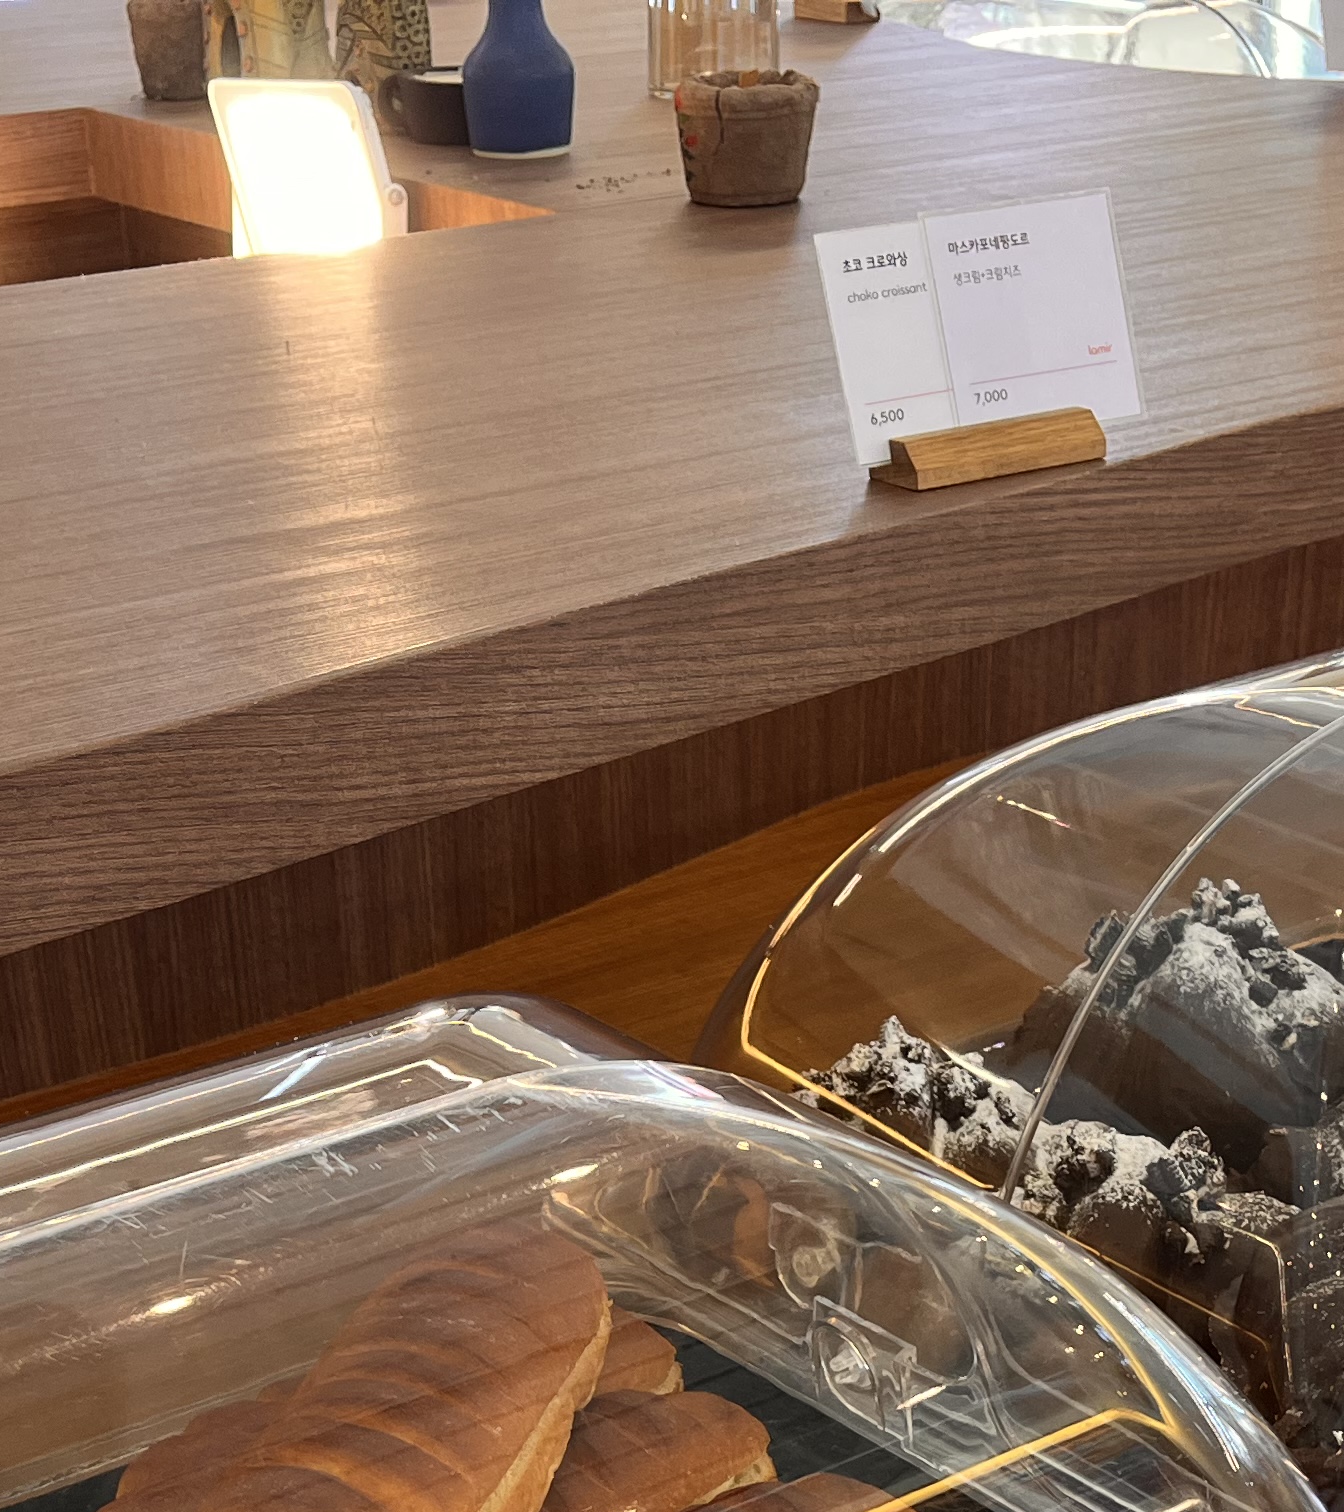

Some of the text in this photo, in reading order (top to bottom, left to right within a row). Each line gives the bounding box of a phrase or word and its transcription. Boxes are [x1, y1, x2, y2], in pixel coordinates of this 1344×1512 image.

[842, 251, 908, 274] 초코 크로와상
[847, 281, 928, 304] choko croissant
[973, 388, 1009, 407] 7,000
[870, 408, 905, 427] 6,500
